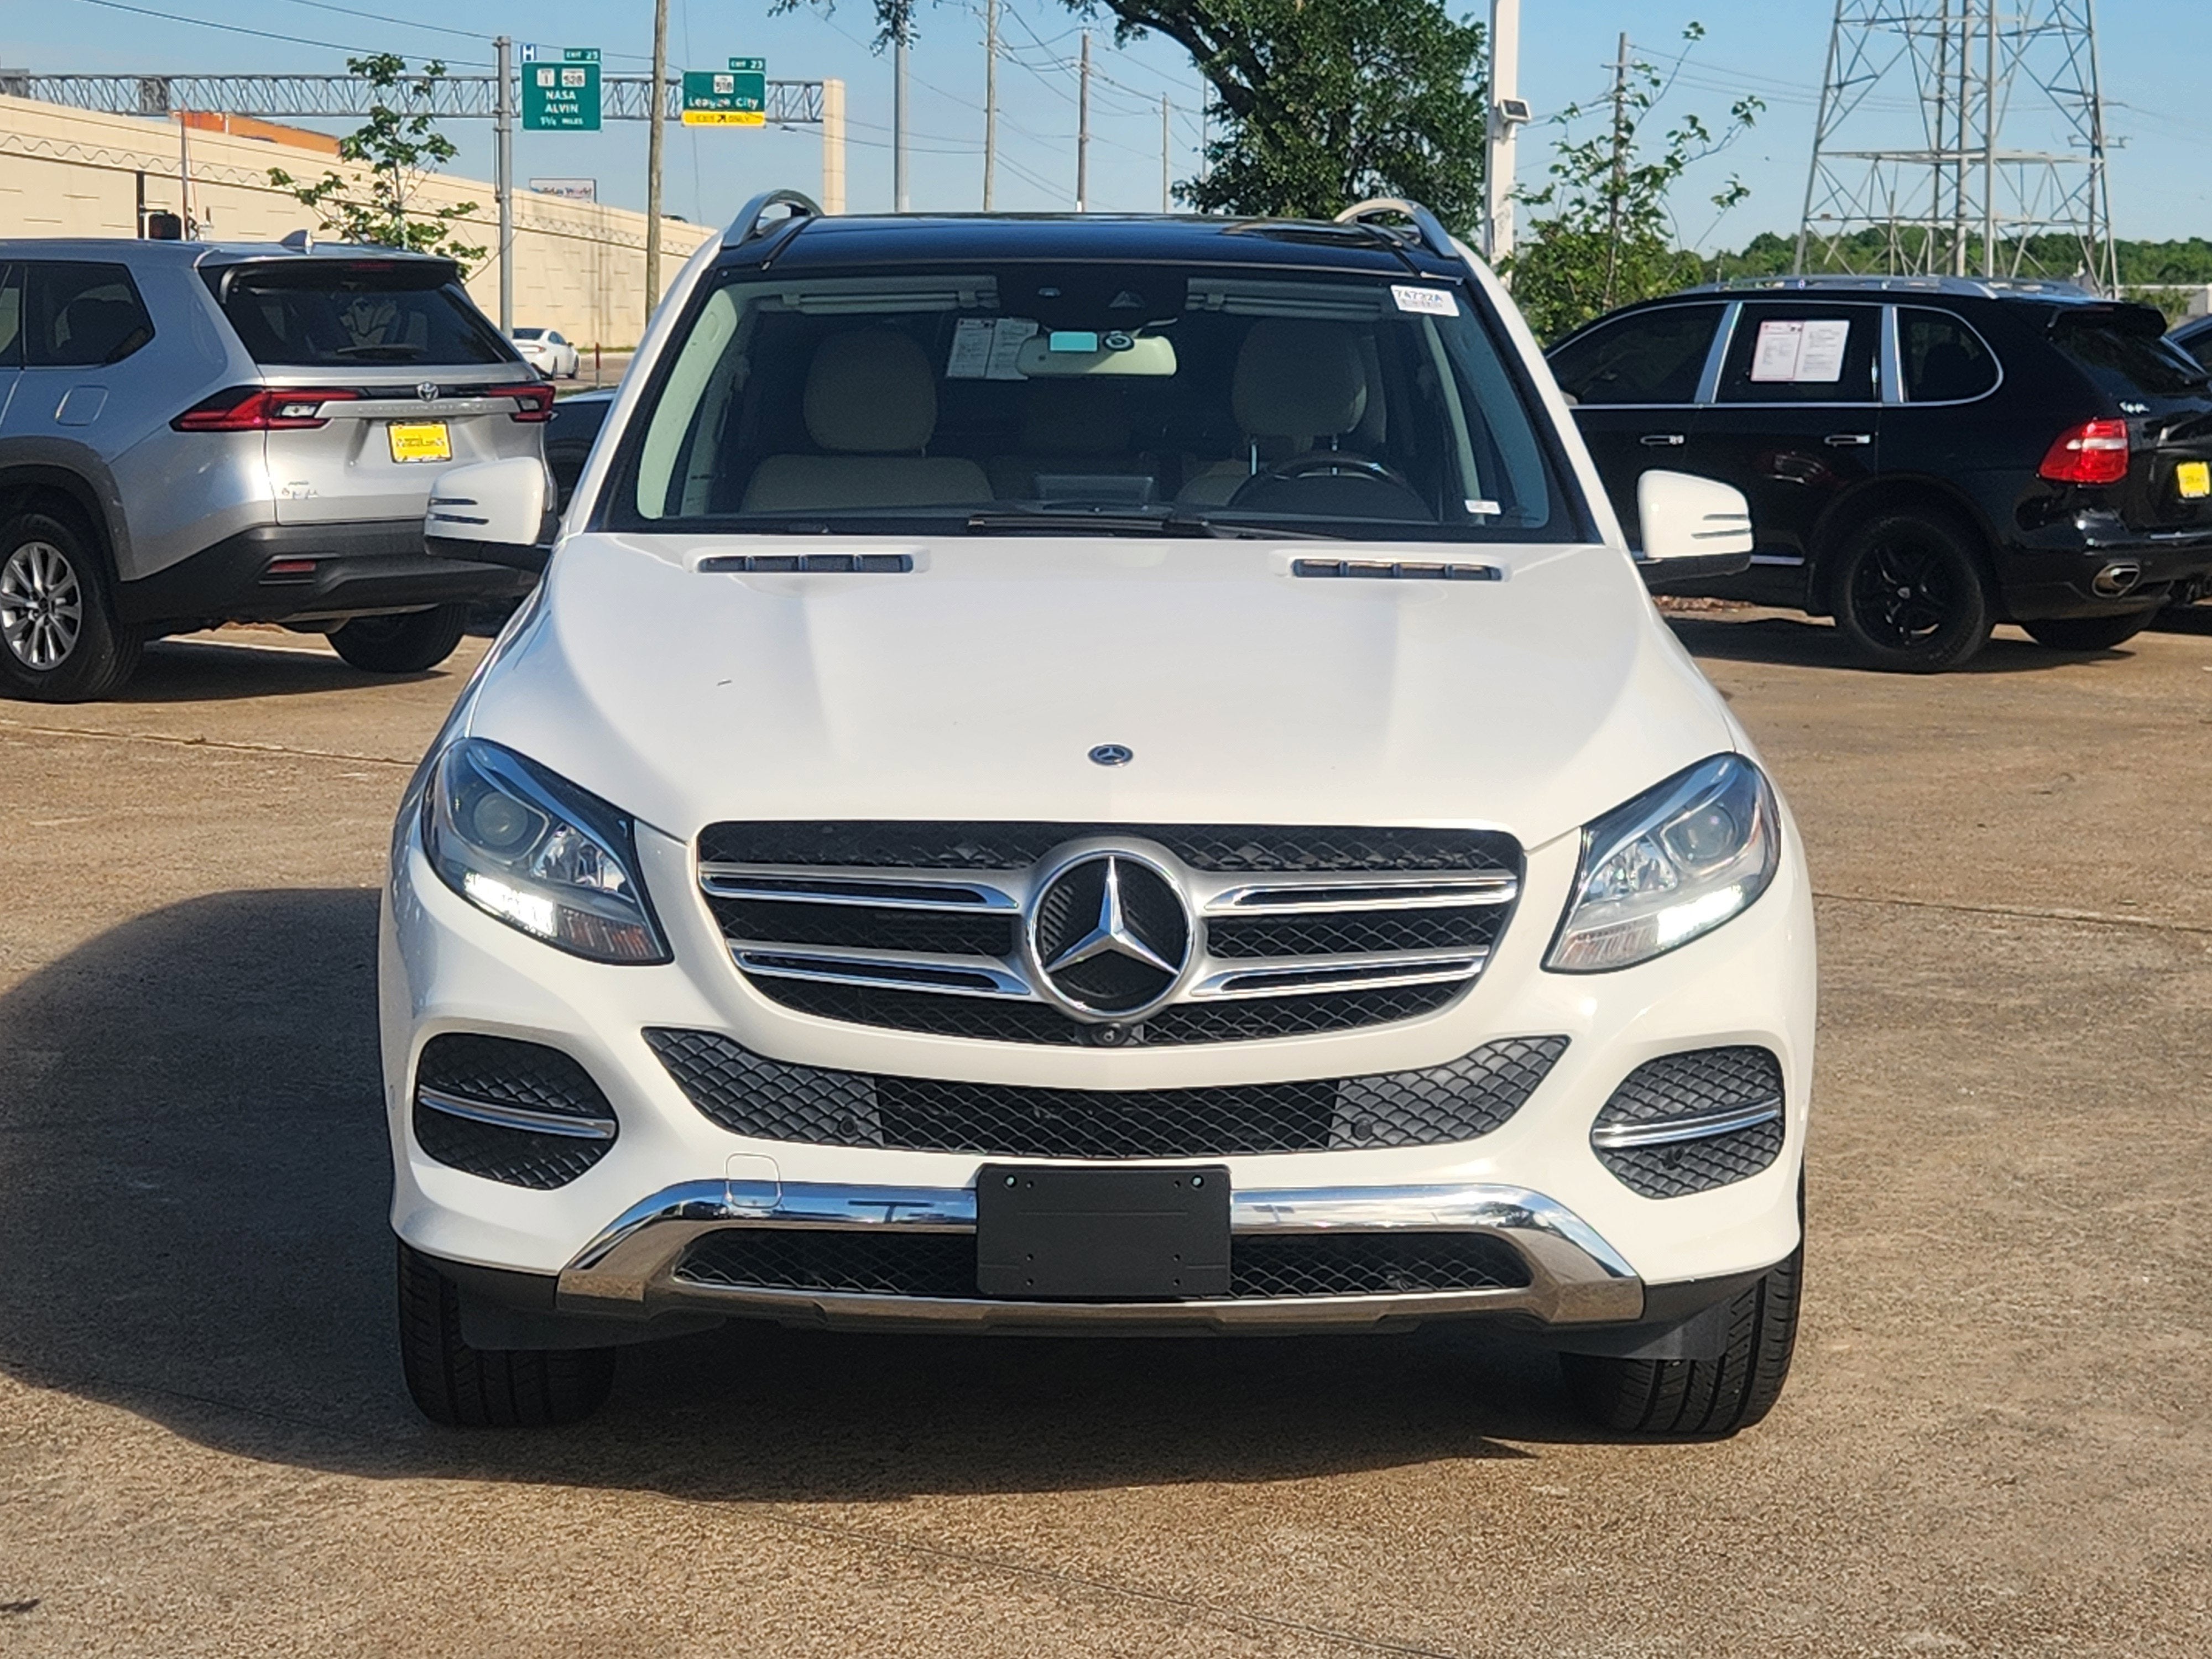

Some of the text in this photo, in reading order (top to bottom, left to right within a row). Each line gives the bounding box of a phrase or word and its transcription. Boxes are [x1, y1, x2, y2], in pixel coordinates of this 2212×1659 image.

[523, 44, 535, 61] H
[563, 75, 583, 85] 528
[545, 90, 576, 100] NASA
[544, 103, 579, 114] ALVIN
[688, 96, 759, 110] League City
